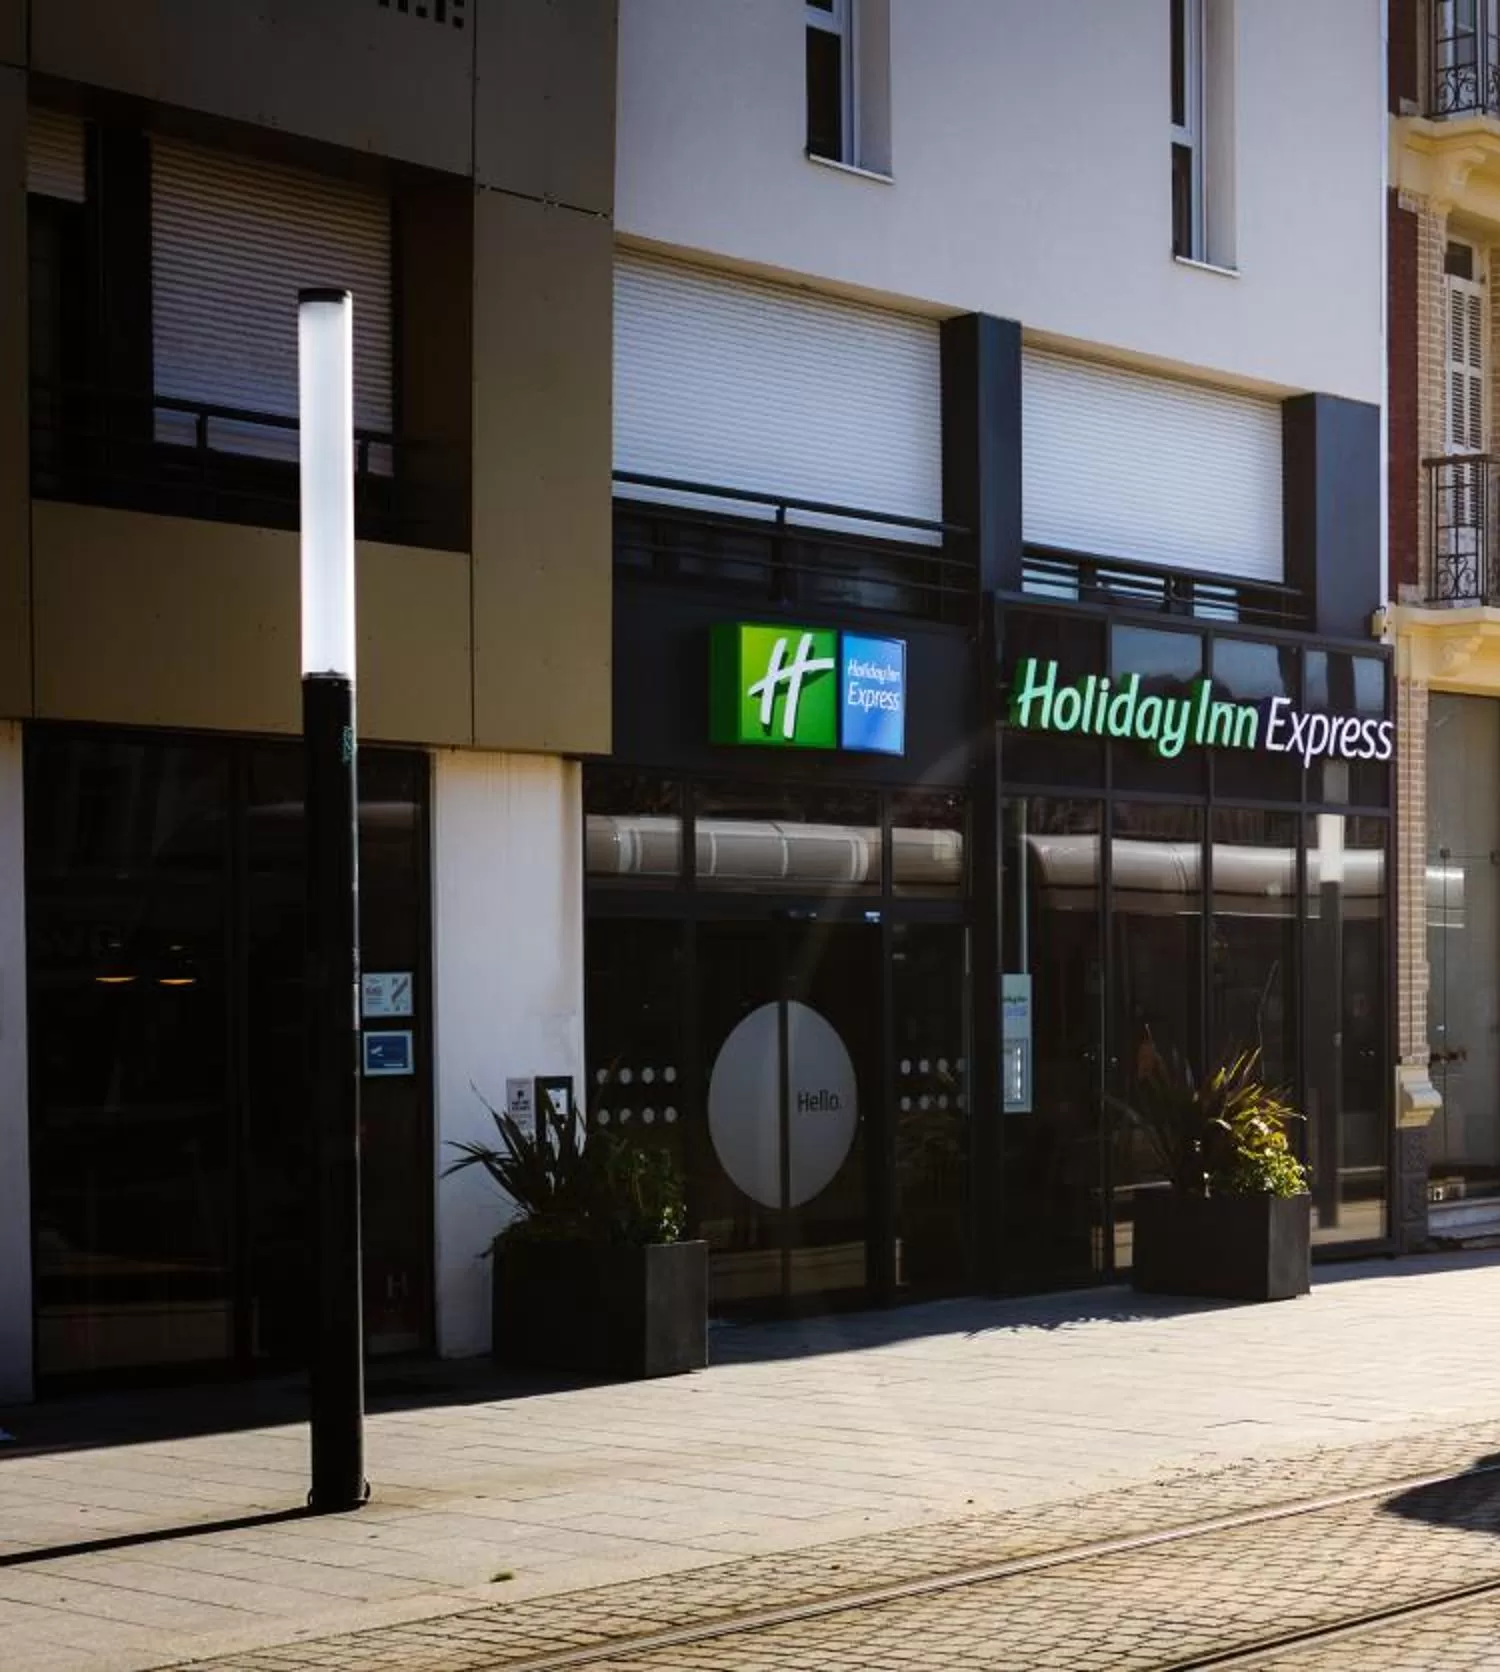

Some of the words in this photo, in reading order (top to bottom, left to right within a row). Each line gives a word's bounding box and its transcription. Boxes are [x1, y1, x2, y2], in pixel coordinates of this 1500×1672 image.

[848, 681, 900, 712] Express
[1017, 657, 1191, 758] Holiday
[1195, 679, 1259, 749] Inn
[1265, 696, 1394, 768] Express
